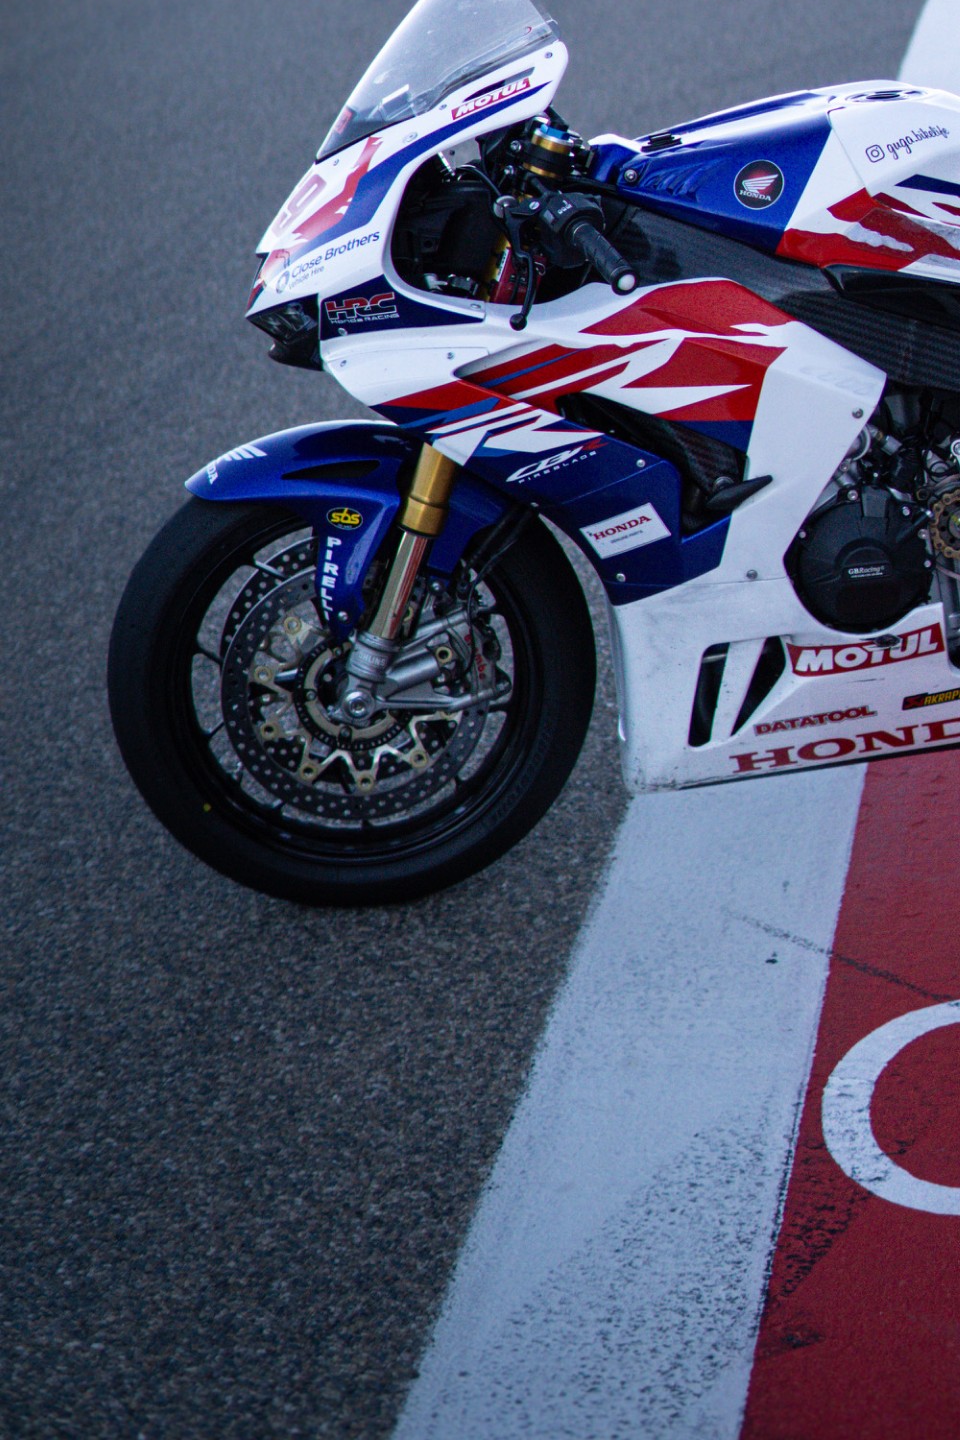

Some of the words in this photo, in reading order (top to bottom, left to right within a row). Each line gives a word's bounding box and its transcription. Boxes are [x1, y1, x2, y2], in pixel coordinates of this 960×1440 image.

[453, 78, 529, 118] MOTUL
[739, 189, 772, 201] HONDA
[291, 254, 322, 278] Close
[324, 231, 380, 261] Brothers
[325, 291, 398, 320] HRC
[592, 515, 652, 541] HONDA
[320, 535, 342, 621] PIRELLI
[795, 628, 942, 672] MOTUL
[755, 705, 876, 736] DATATOOL
